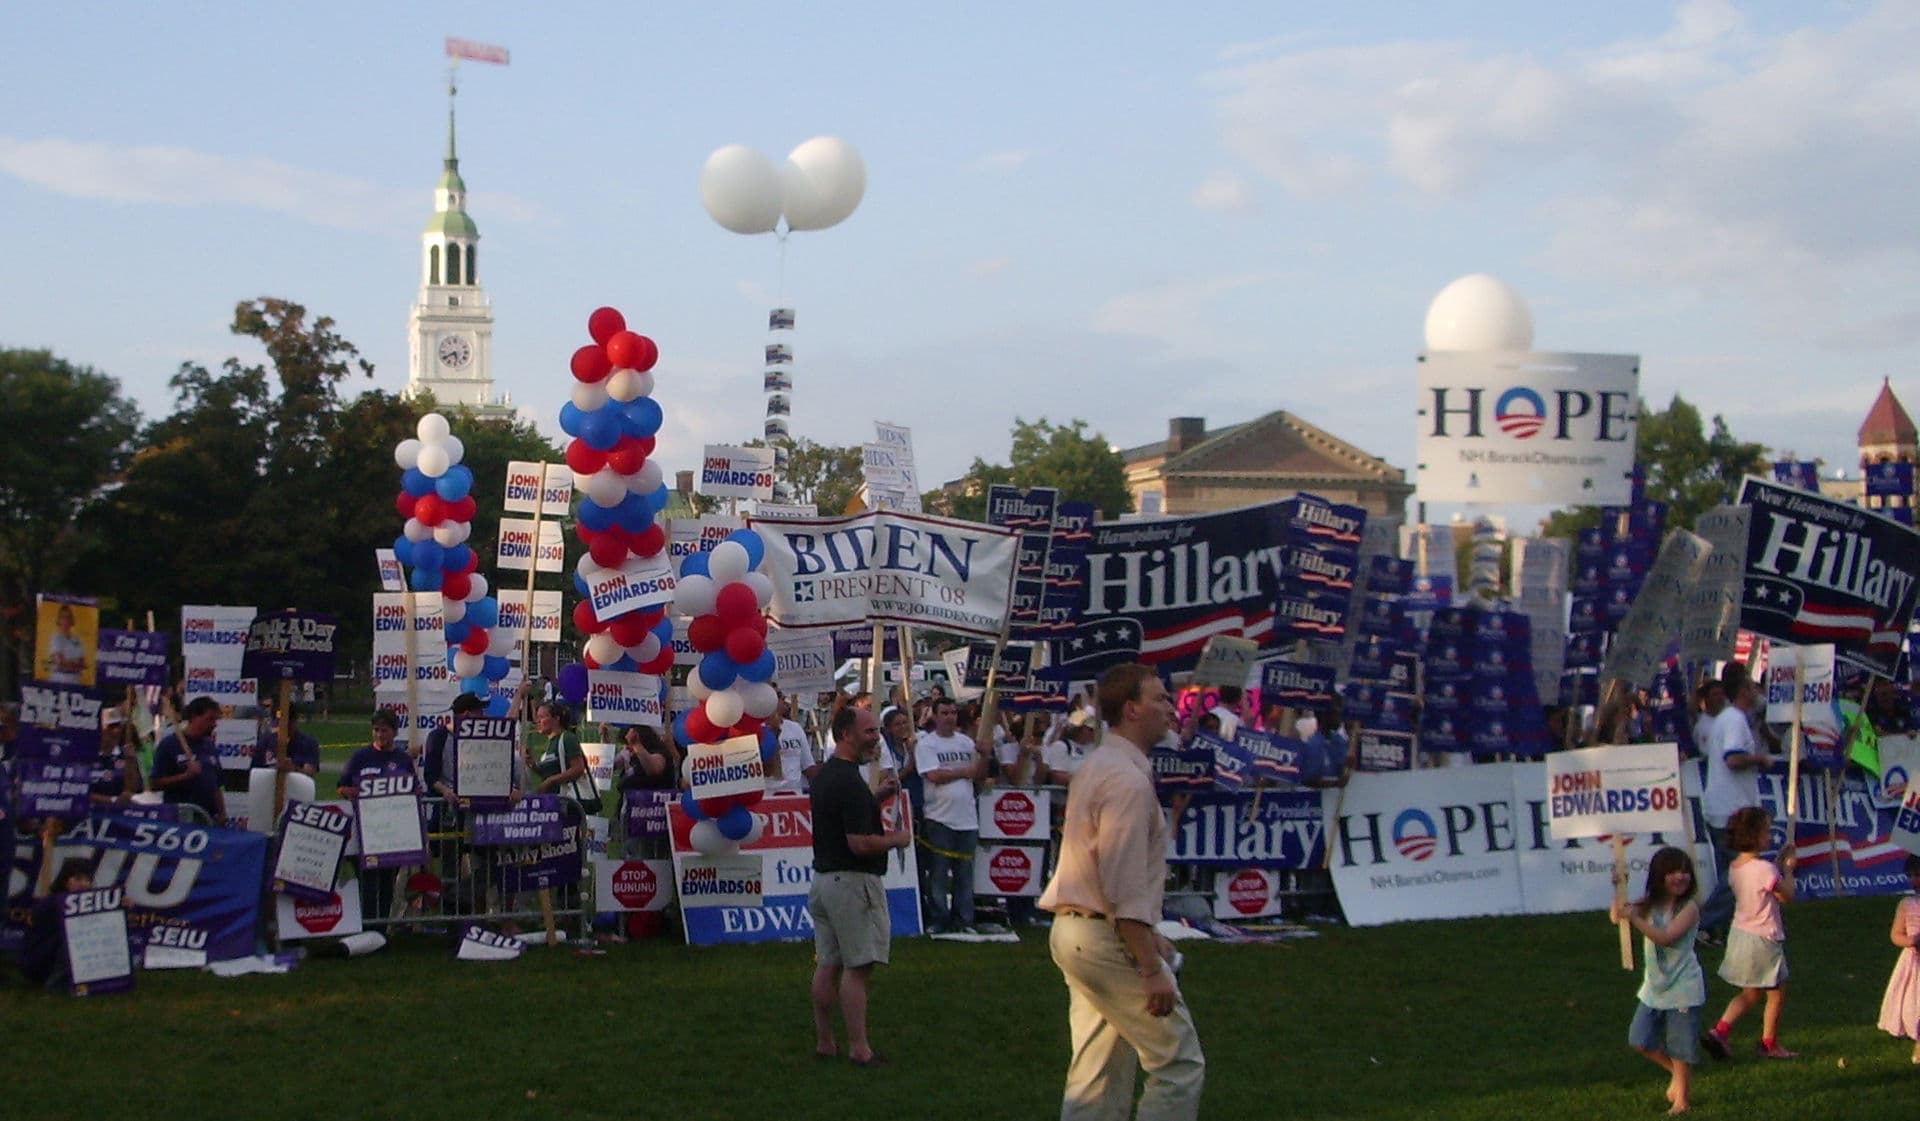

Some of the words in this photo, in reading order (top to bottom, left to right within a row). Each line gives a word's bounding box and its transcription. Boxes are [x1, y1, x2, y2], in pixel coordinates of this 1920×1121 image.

[1430, 387, 1629, 441] HOPE
[704, 457, 730, 469] JOHN
[509, 474, 539, 487] JOHN
[702, 471, 772, 487] EDWARDS08
[507, 487, 569, 504] EDWADS08
[994, 498, 1048, 519] Hillary
[1298, 503, 1359, 534] Hillary
[501, 531, 532, 543] JOHN
[784, 524, 979, 583] BIDEN
[1290, 551, 1351, 579] Hillary
[1753, 512, 1915, 629] Hillary
[592, 576, 627, 597] JOHN
[595, 577, 676, 611] EDWARDS08
[819, 574, 931, 601] PRESENT
[1282, 600, 1342, 626] Hillary
[185, 631, 248, 645] EDWARDS0
[376, 655, 407, 666] JOHN
[777, 652, 826, 670] BIDEN
[973, 655, 1025, 674] Hilary
[590, 683, 622, 696] JOHN
[1268, 669, 1327, 691] Hillary
[590, 696, 661, 715] EDWARDS08
[459, 719, 511, 738] SEIU
[1238, 736, 1298, 766] Hillary
[691, 755, 723, 771] JOHN
[359, 775, 414, 797] SEIU
[692, 764, 762, 786] EDWARDS08
[1551, 770, 1601, 794] JOHN
[1552, 787, 1678, 818] EDWARDS08
[291, 804, 348, 833] SEIU
[130, 820, 209, 854] 560
[1165, 803, 1324, 869] illary
[1339, 801, 1516, 868] HOPE
[621, 870, 648, 881] STOP
[683, 867, 717, 881] JOHN
[682, 880, 761, 895] EDWARDS08
[65, 888, 122, 915] SEIU
[149, 926, 208, 948] SEIU
[466, 926, 522, 949] SEIU
